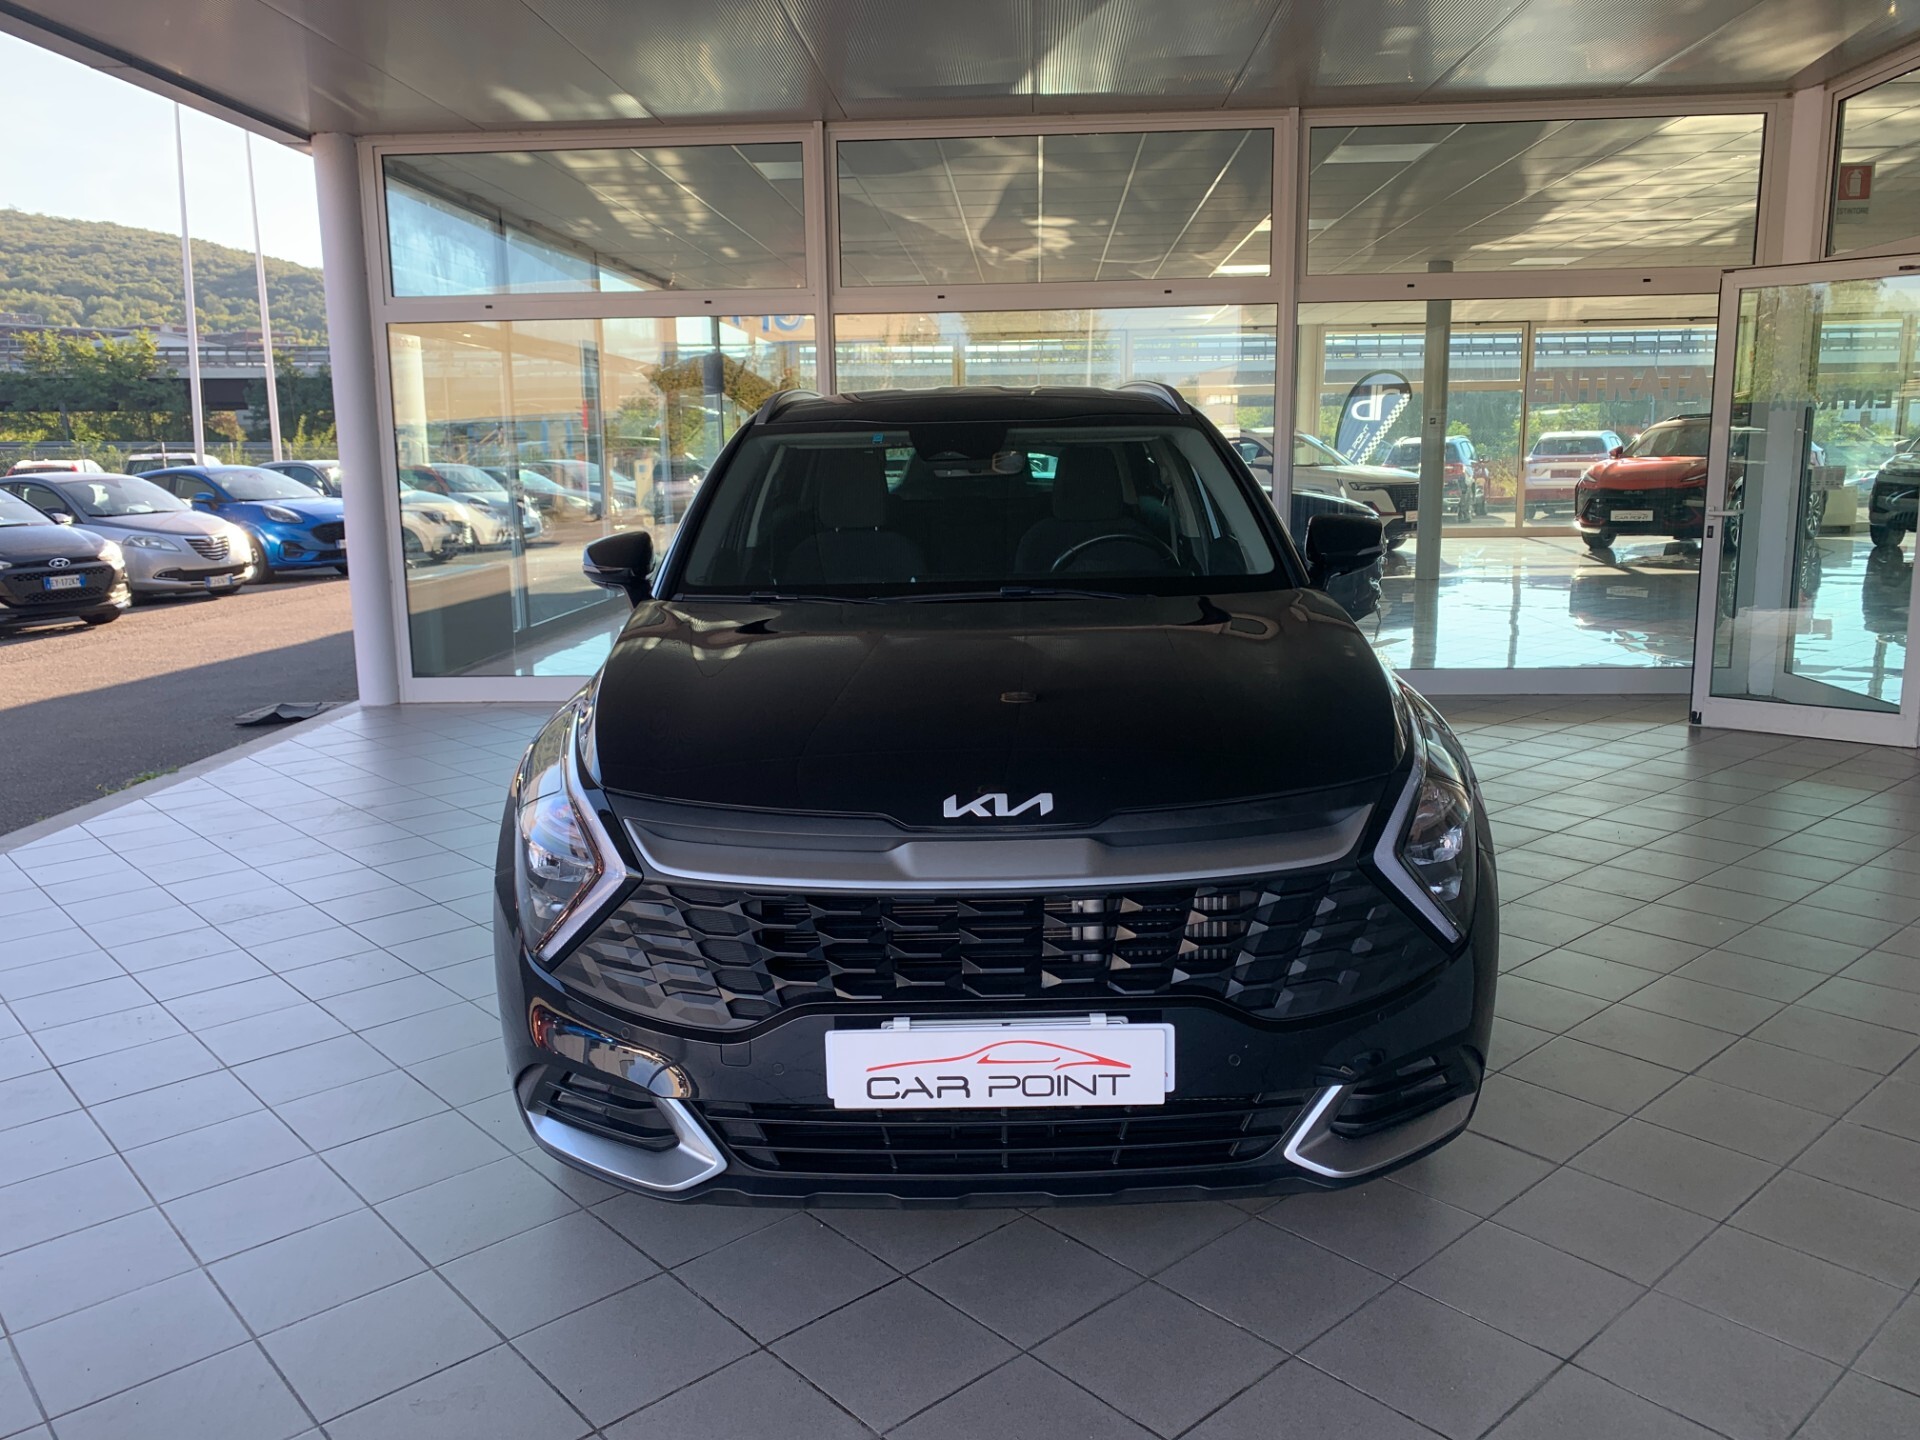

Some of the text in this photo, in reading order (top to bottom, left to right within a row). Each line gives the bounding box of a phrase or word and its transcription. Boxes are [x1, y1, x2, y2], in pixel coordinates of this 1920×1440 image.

[1527, 366, 1712, 403] ENTRATA
[943, 793, 1053, 818] KIA
[866, 1074, 1131, 1100] CAR POINT
